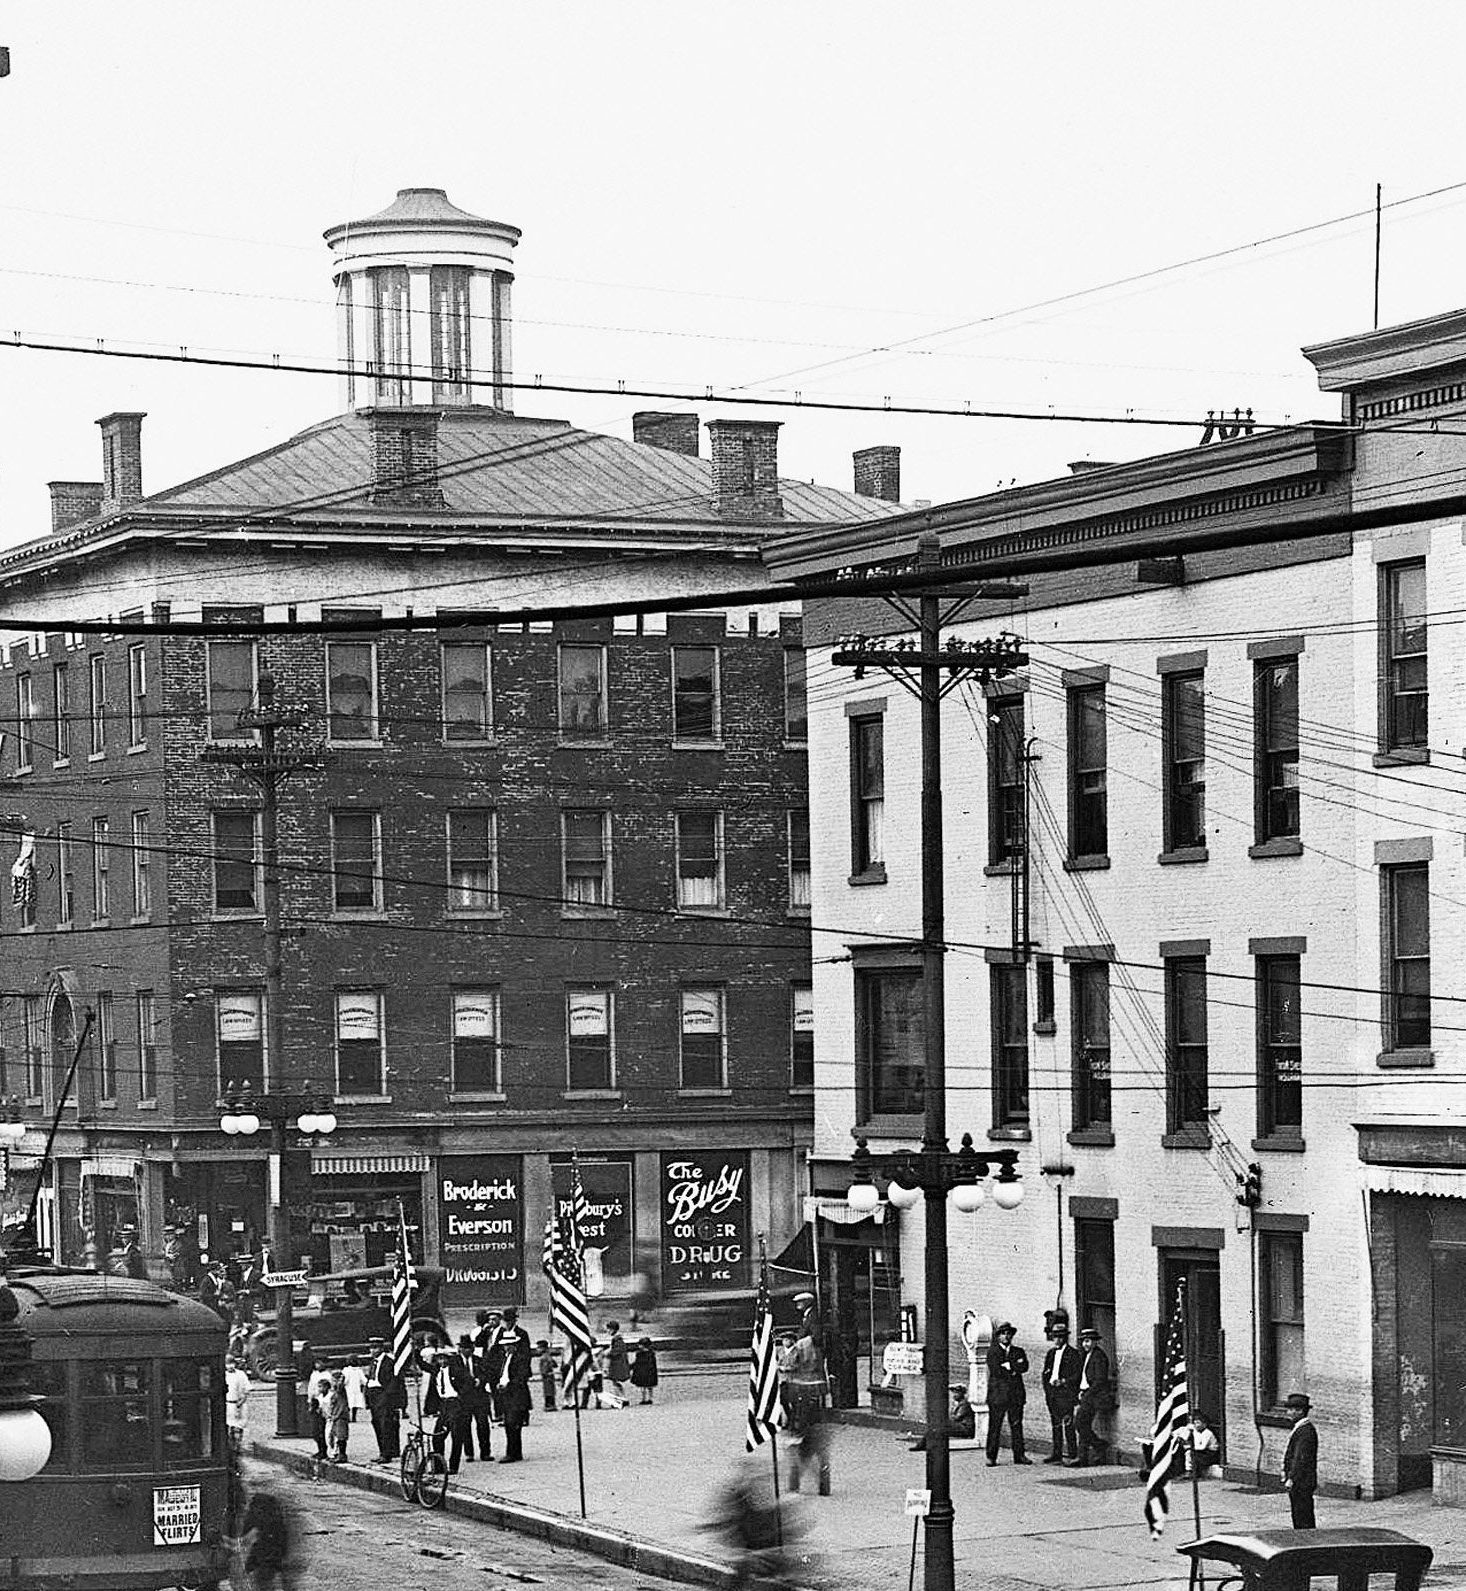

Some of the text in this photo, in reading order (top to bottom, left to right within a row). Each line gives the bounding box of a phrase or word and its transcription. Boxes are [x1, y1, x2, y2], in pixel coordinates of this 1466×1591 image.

[666, 1162, 703, 1179] The
[443, 1179, 516, 1201] Broderick
[666, 1164, 743, 1225] Busy
[448, 1215, 513, 1235] Everson
[669, 1245, 743, 1263] DRUG
[266, 1273, 302, 1285] SYRACUSE
[157, 1512, 198, 1527] MARRIED
[161, 1526, 195, 1539] FLIRTS
